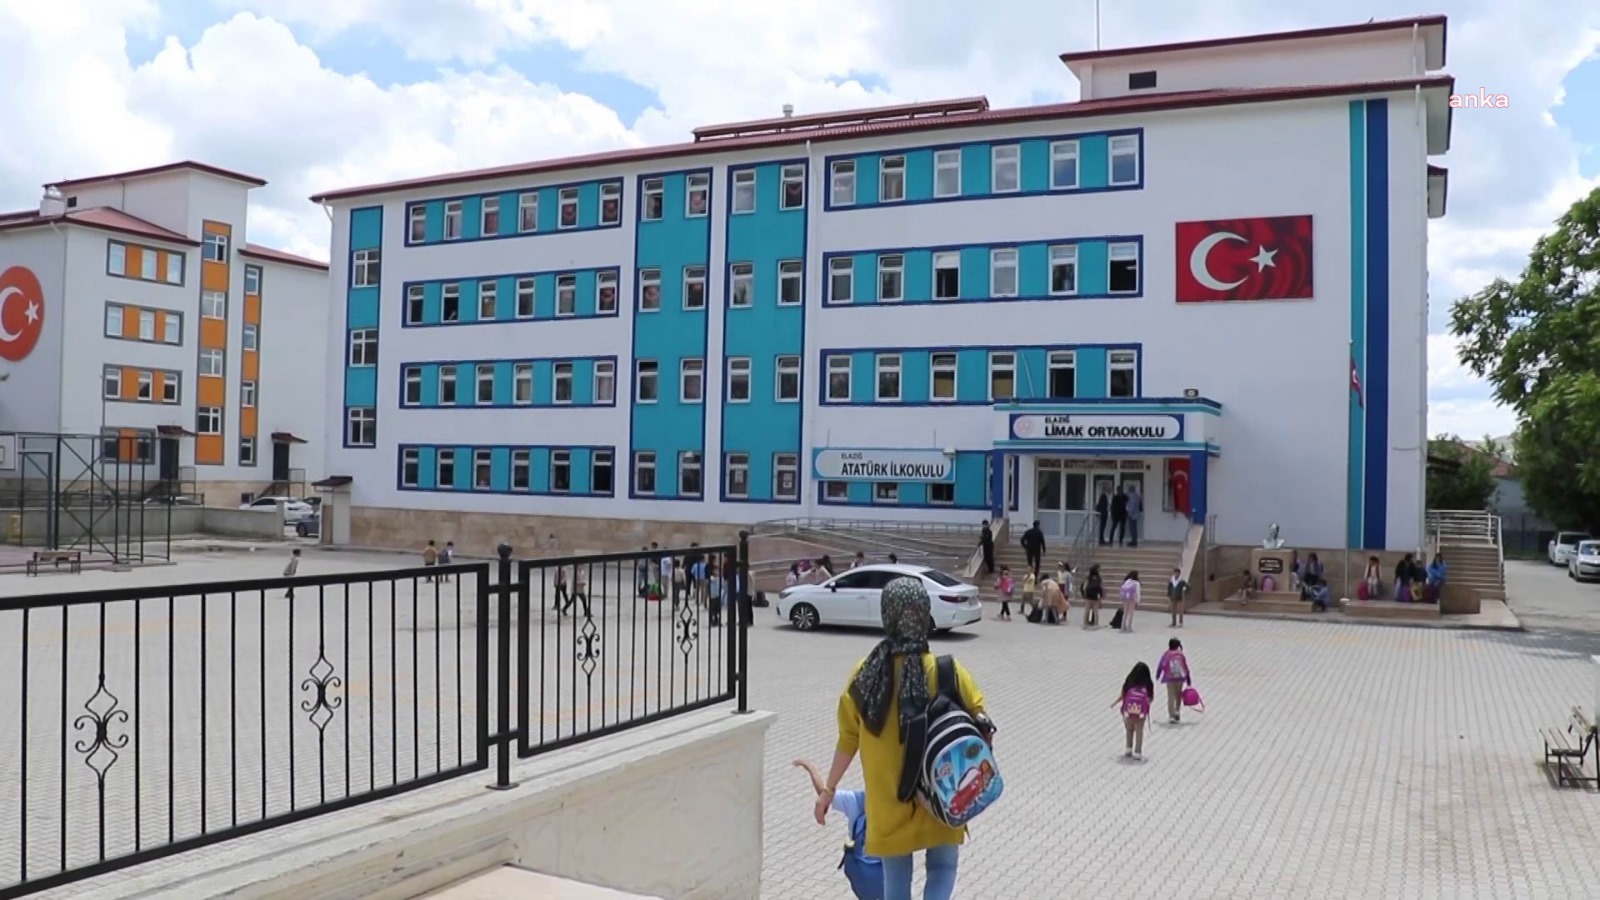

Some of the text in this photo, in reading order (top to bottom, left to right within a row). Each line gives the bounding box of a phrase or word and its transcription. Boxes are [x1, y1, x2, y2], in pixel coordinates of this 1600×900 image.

[1045, 424, 1165, 437] LİMAK ORTAOKULU
[841, 460, 944, 478] ATATÜRK İLKOKULU
